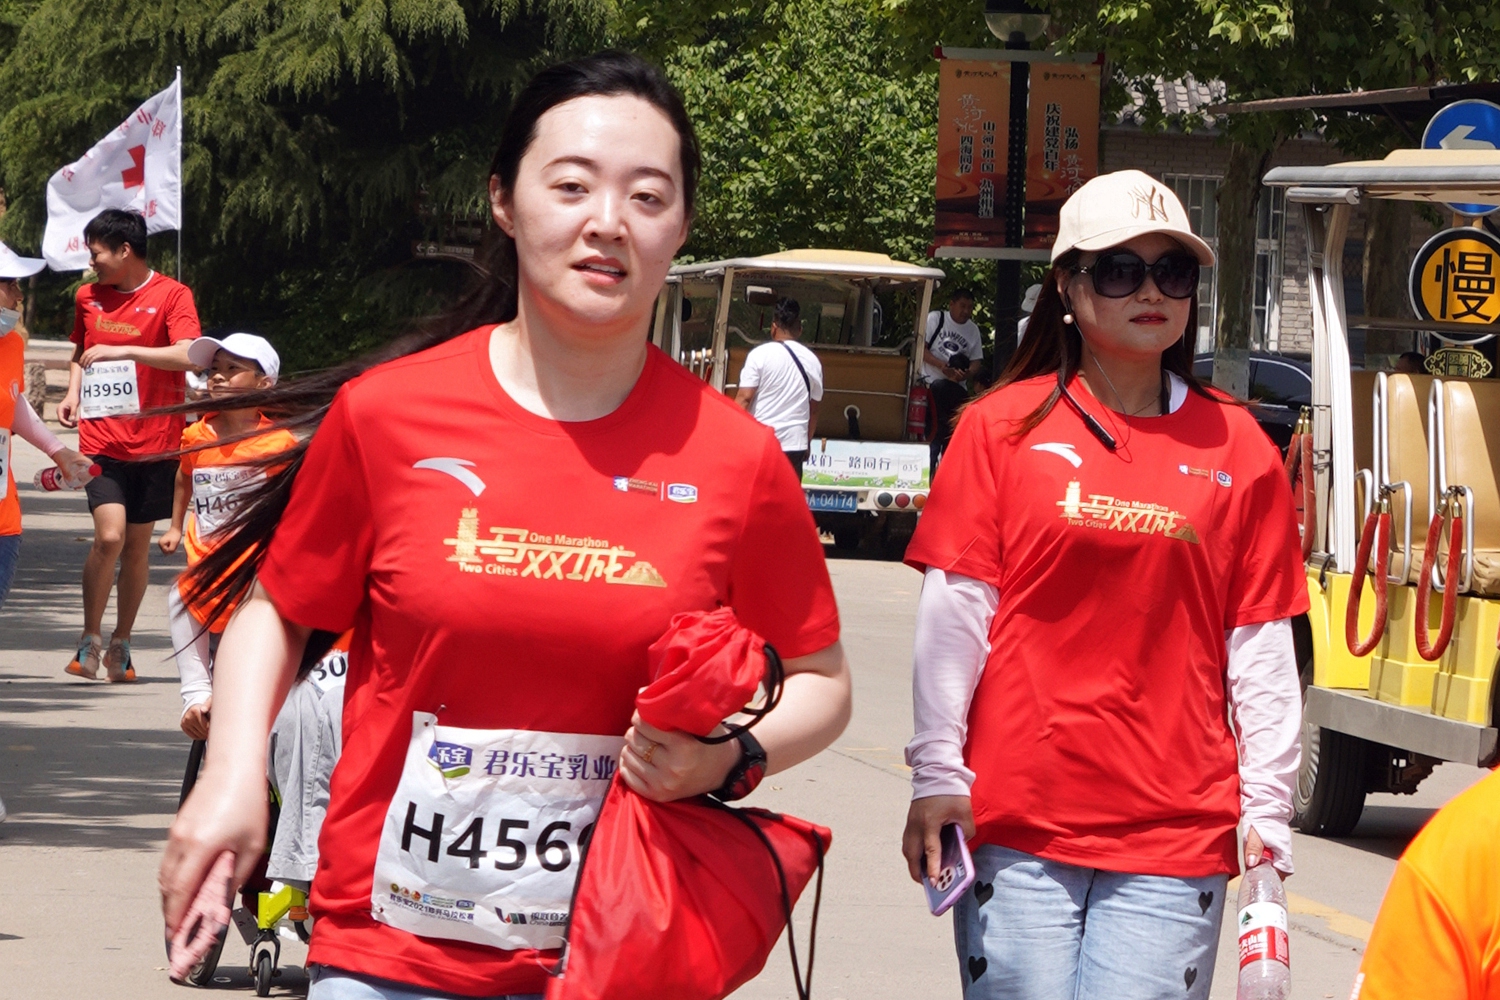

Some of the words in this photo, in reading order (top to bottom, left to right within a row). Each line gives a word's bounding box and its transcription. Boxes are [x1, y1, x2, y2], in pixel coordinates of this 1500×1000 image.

[1435, 248, 1495, 322] 慢
[83, 381, 133, 399] H3950
[805, 454, 892, 471] 我们一路同行
[902, 464, 919, 473] 035
[530, 532, 552, 544] One
[554, 534, 609, 548] Marathon
[459, 562, 482, 574] Two
[485, 564, 518, 577] Cities
[483, 749, 616, 781] 君乐宝乳业
